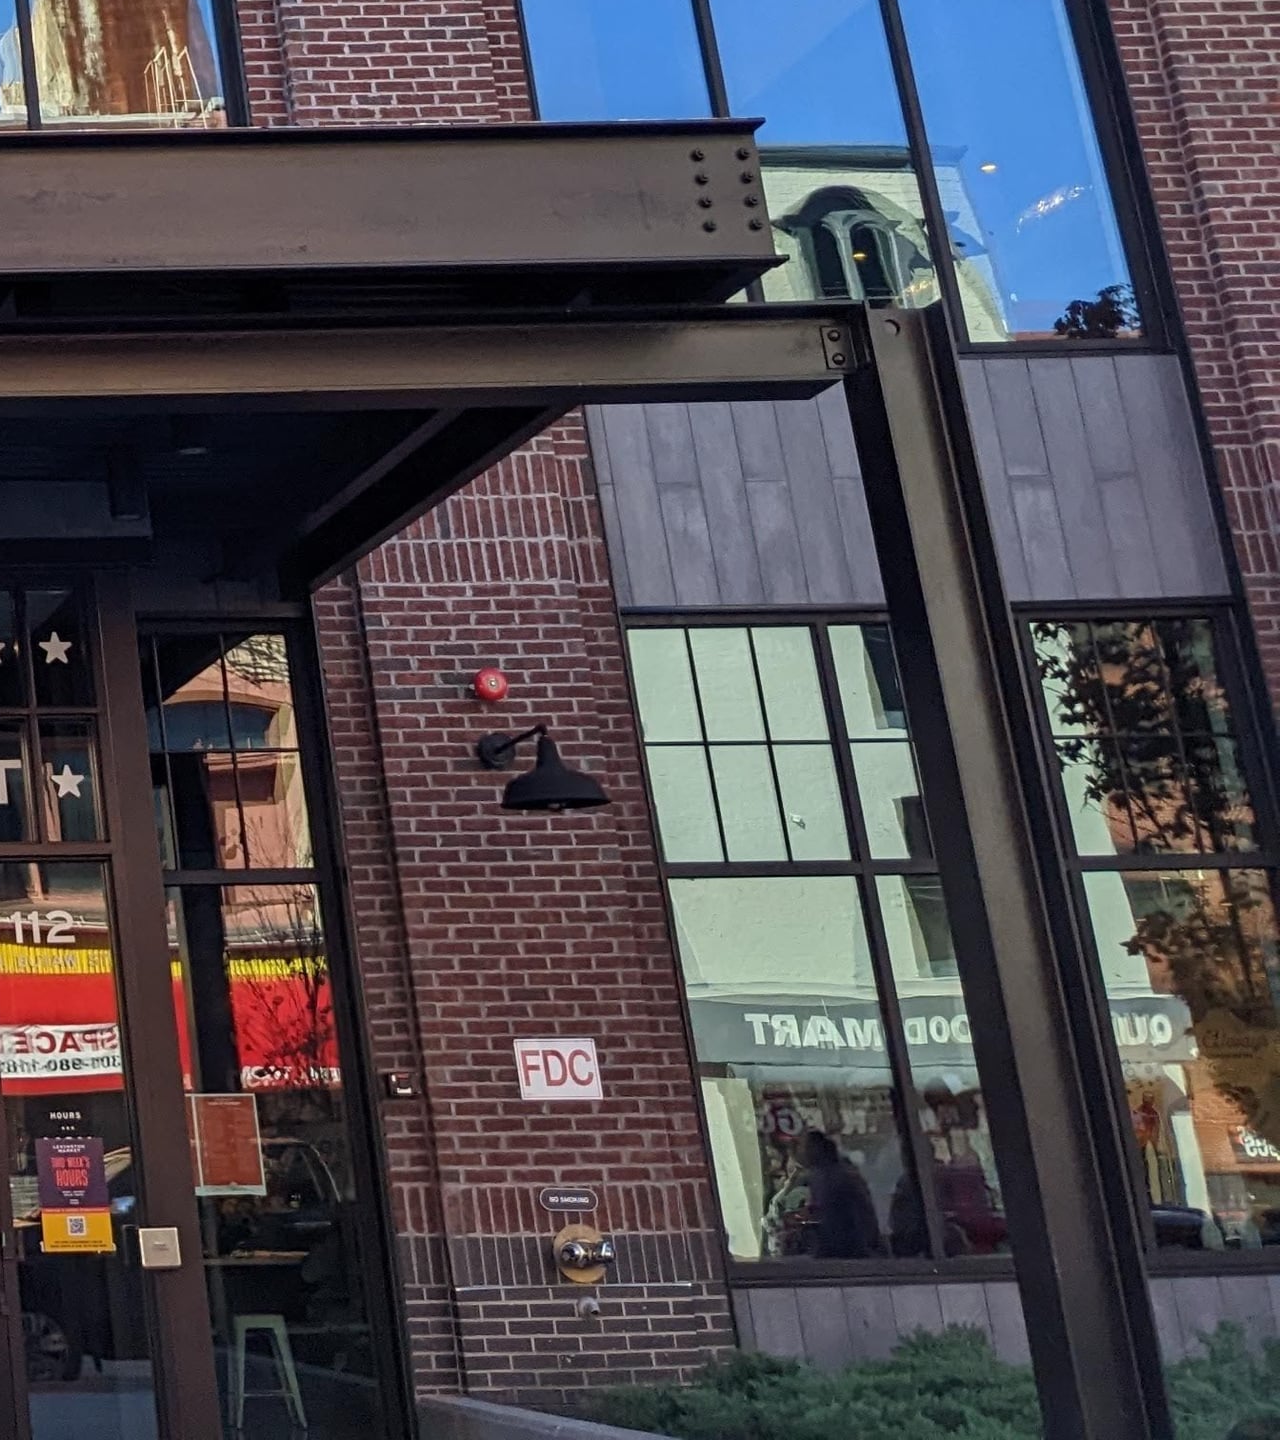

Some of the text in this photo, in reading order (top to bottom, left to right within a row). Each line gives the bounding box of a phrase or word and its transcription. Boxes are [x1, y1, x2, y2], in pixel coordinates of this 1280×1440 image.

[10, 910, 76, 943] 112
[519, 1048, 595, 1087] FDC
[50, 1112, 82, 1120] HOURS
[56, 1168, 89, 1187] HOURS
